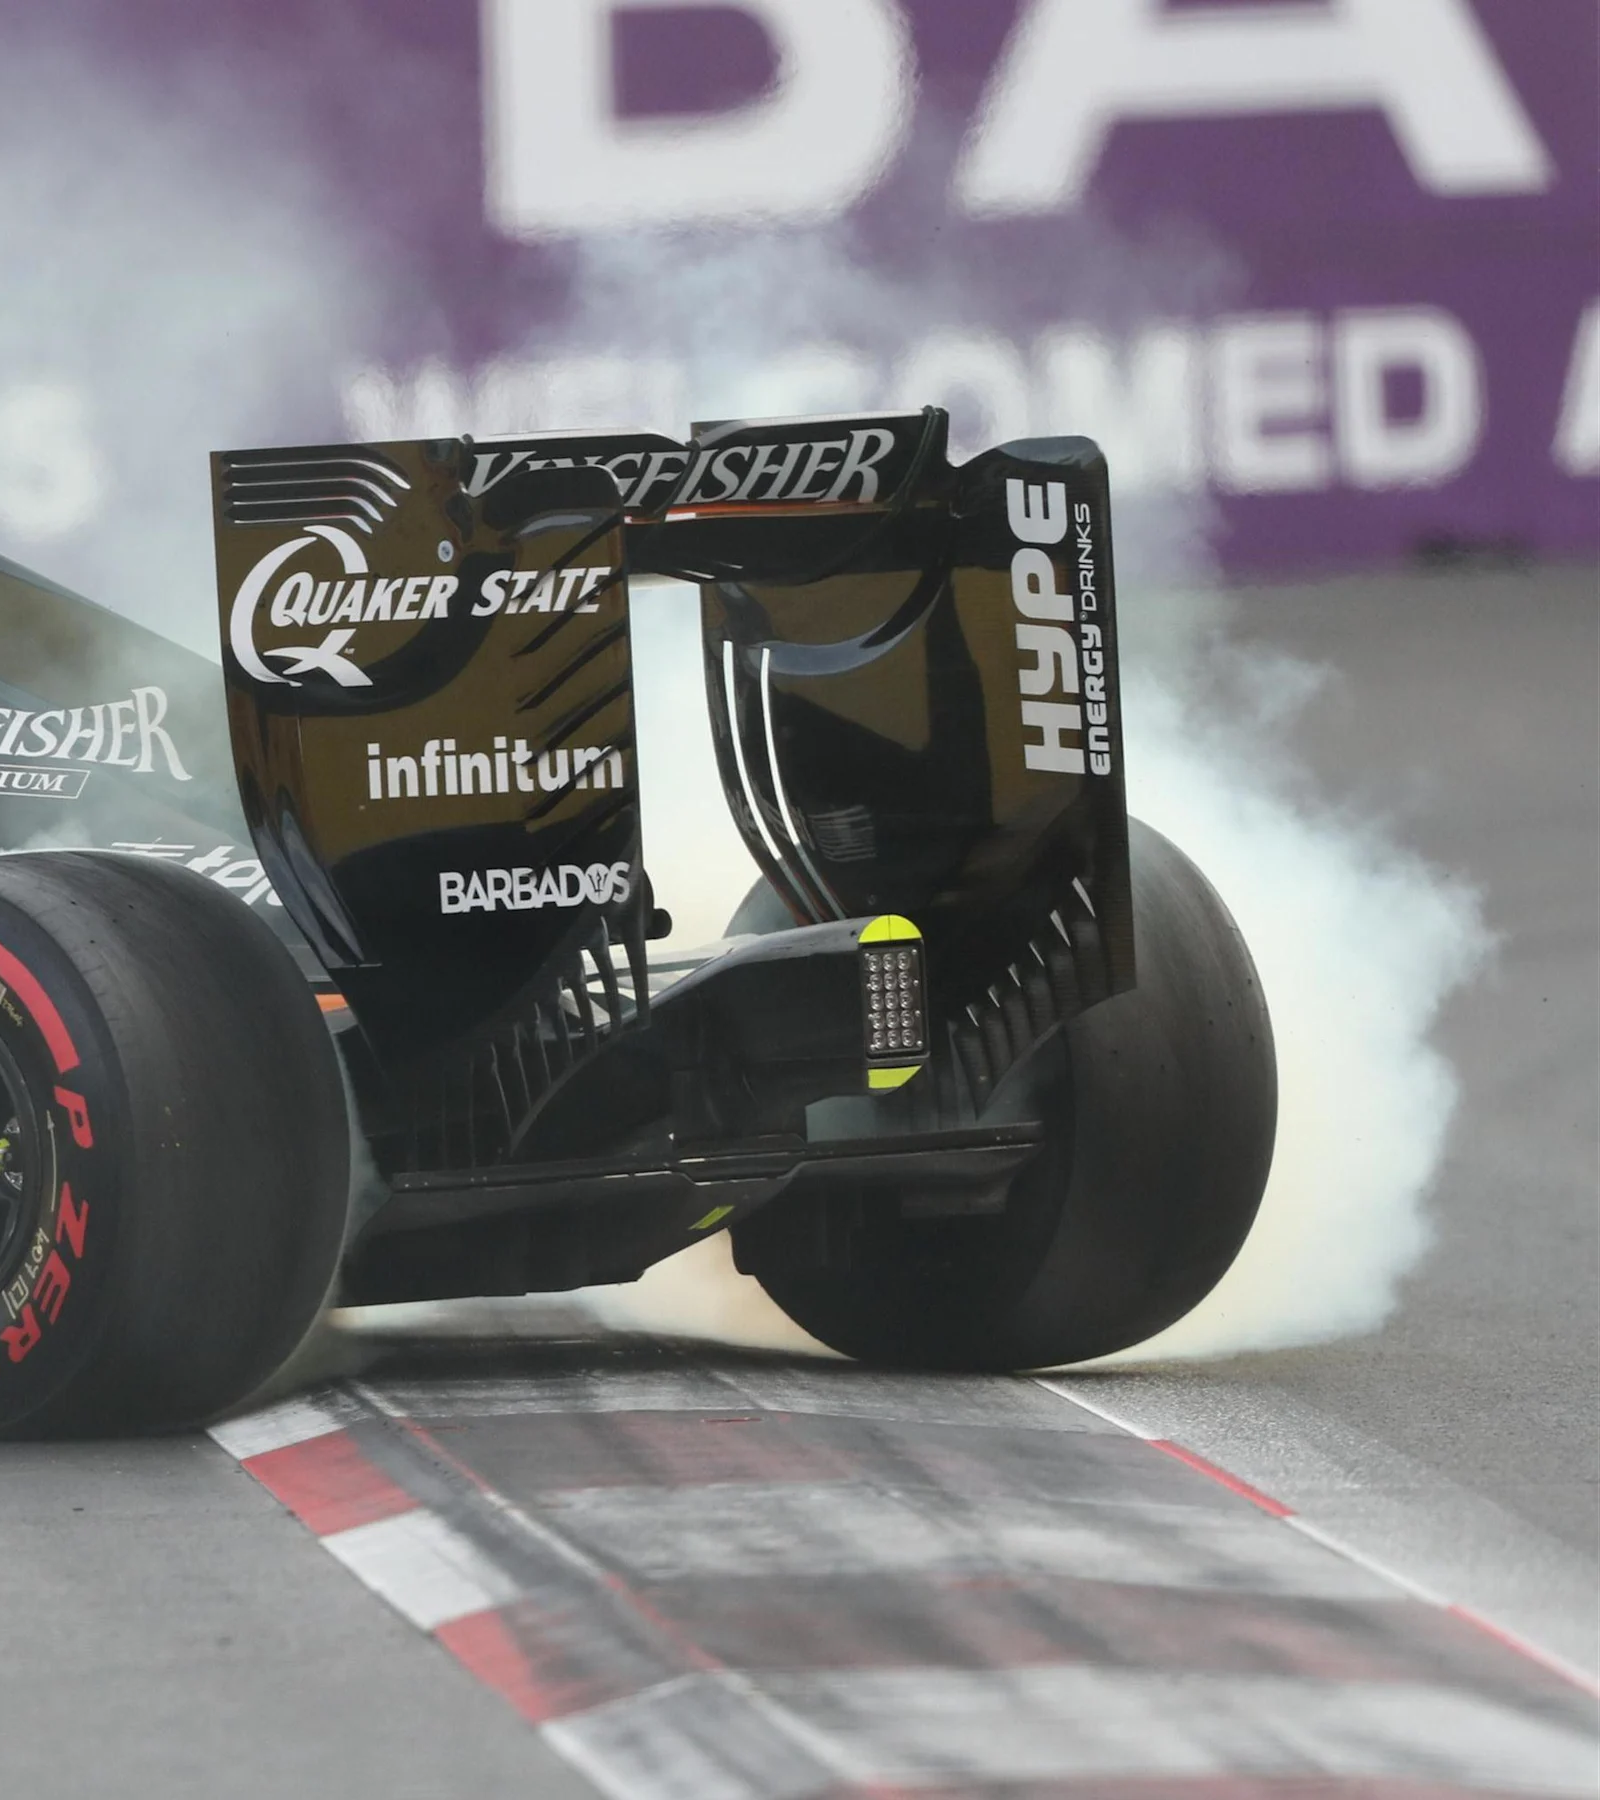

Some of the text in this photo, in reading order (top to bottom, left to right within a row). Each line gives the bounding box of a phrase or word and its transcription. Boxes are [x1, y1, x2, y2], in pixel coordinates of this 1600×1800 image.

[270, 566, 612, 628] QUAKER STATE
[1005, 478, 1086, 774] HYPE
[1074, 502, 1112, 777] ENERGY DRINKS
[367, 736, 624, 800] infinitum
[439, 861, 631, 915] BARBADOS
[54, 1085, 94, 1149] P
